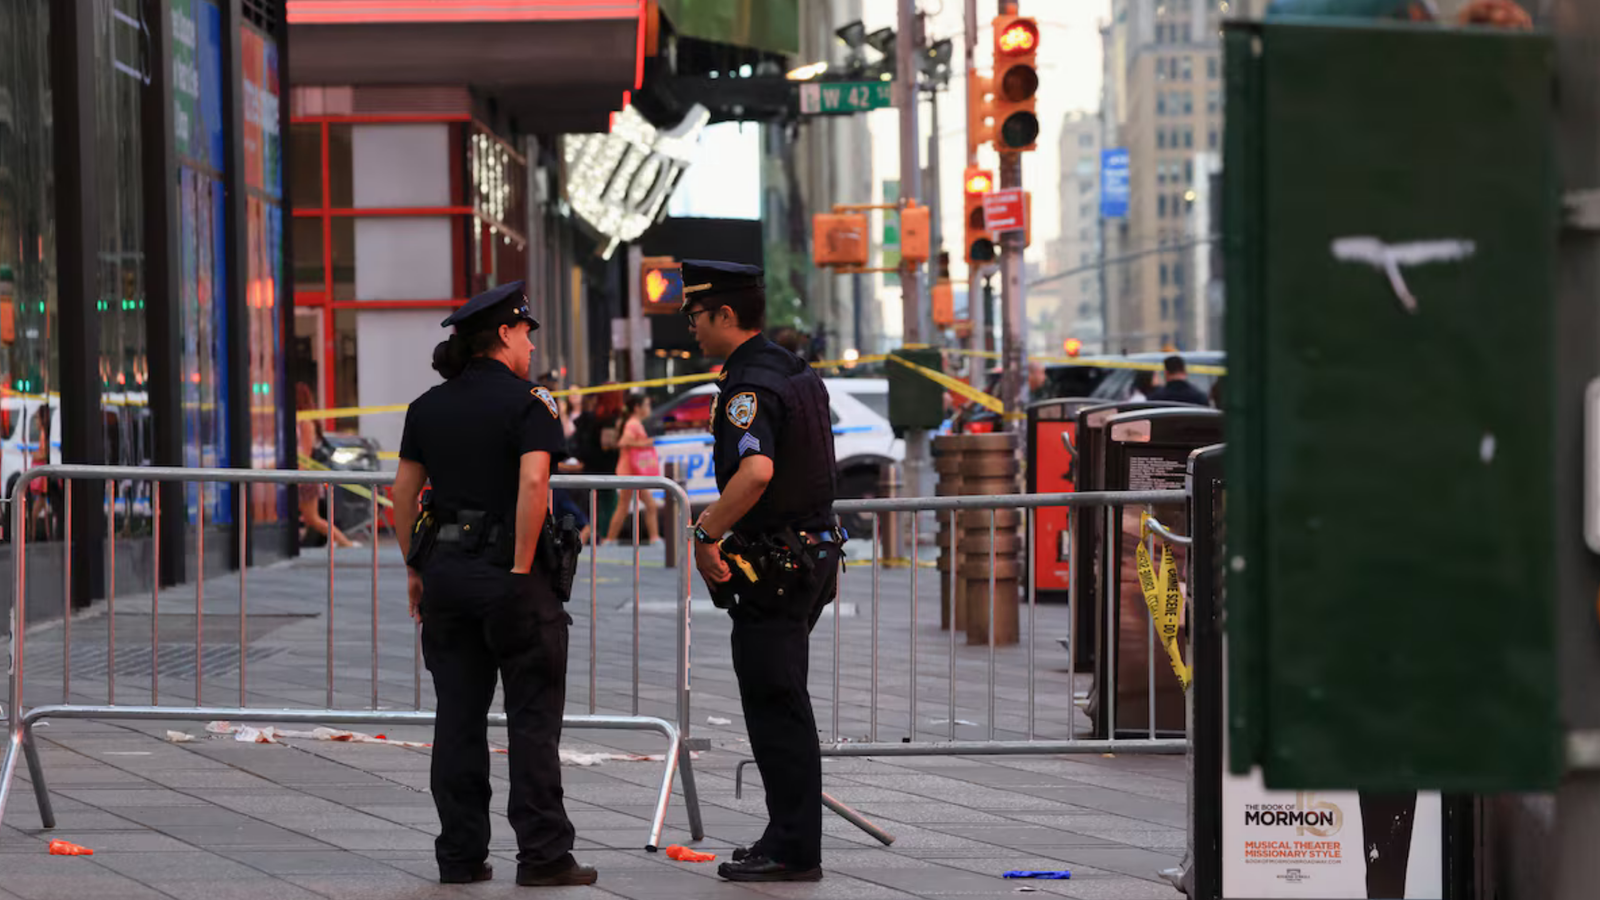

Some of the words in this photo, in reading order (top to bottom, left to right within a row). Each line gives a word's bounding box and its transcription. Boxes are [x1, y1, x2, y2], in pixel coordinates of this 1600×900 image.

[822, 88, 840, 109] W
[848, 86, 872, 107] 42
[1166, 568, 1179, 593] CRIME
[1164, 593, 1179, 617] SCENE
[1244, 811, 1334, 826] MORMON
[1244, 841, 1292, 849] MUSICAL
[1244, 850, 1308, 858] MISSIONARY
